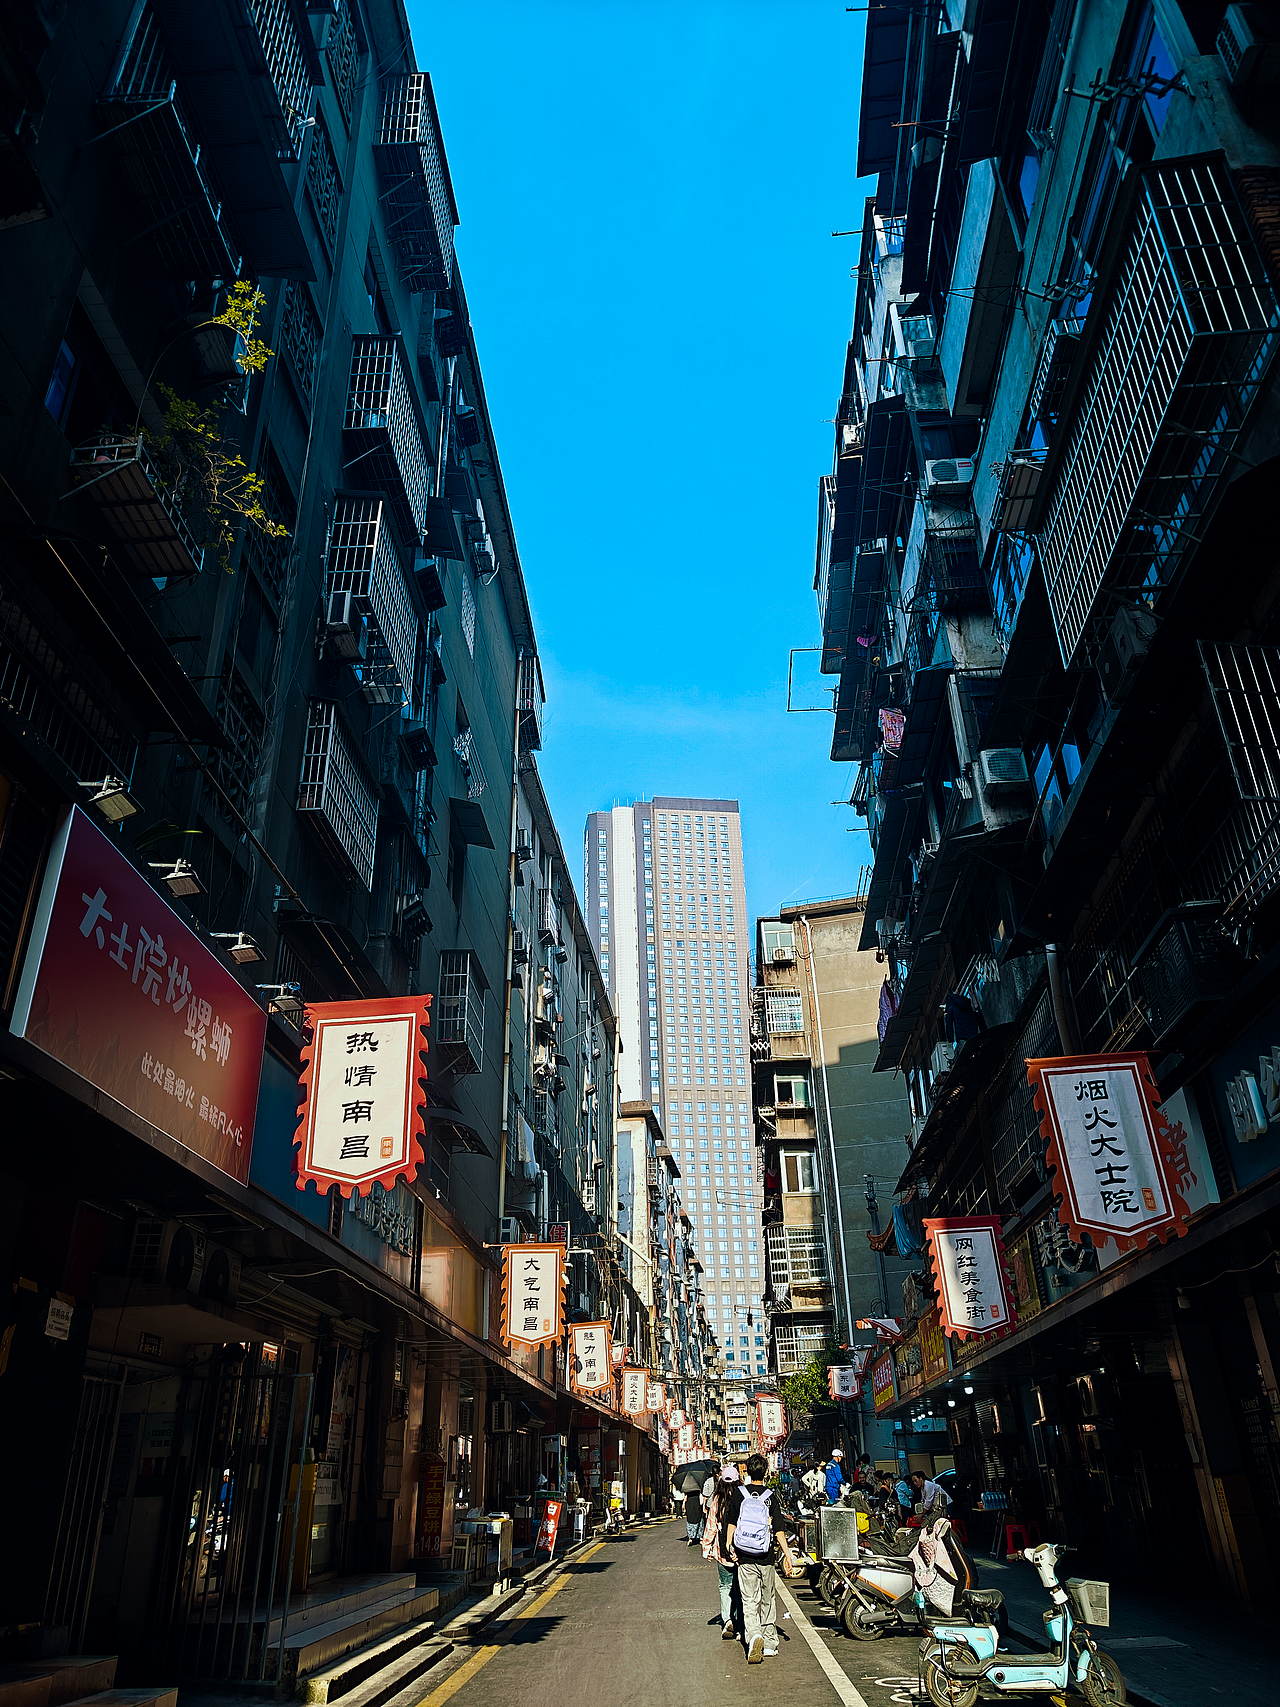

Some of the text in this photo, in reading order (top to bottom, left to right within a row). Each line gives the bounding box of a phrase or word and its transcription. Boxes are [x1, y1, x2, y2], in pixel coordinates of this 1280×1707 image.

[79, 887, 232, 1067] 大士院炒螺蛳
[141, 1052, 195, 1109] 此处最烟火
[339, 1032, 379, 1159] 热情南昌
[1074, 1079, 1140, 1214] 烟火大士院
[523, 1257, 540, 1331] 大气南昌
[955, 1237, 986, 1320] 网红美食街
[423, 1465, 444, 1533] 手工绿豆饼
[420, 1535, 440, 1551] 14.8
